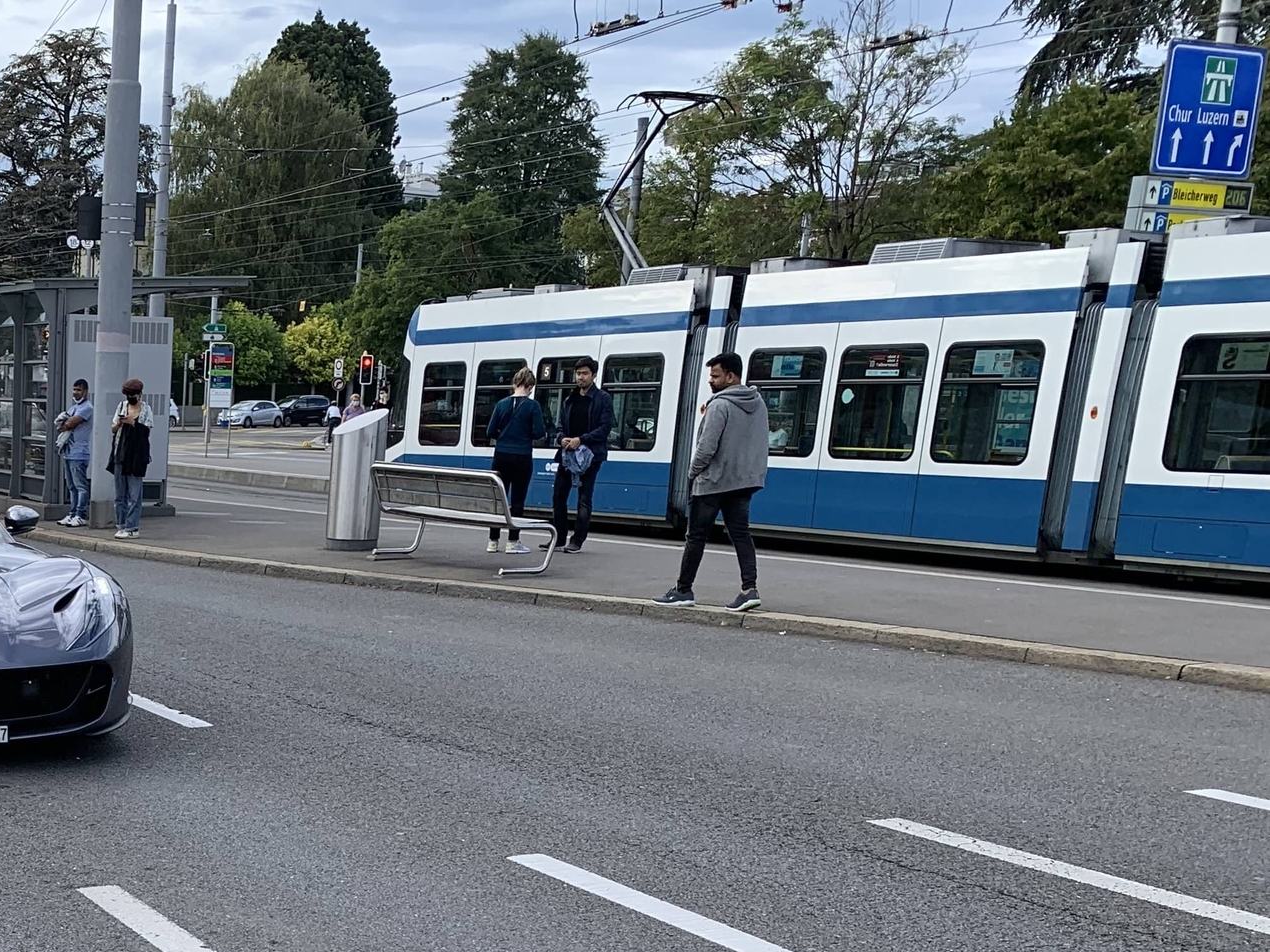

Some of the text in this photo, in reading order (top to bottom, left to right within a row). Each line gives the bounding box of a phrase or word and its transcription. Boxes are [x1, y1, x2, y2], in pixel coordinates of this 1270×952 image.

[1169, 105, 1229, 125] Chur Luzern
[1173, 189, 1218, 205] Bleicherweg
[1225, 190, 1247, 206] 206
[544, 367, 549, 377] 5
